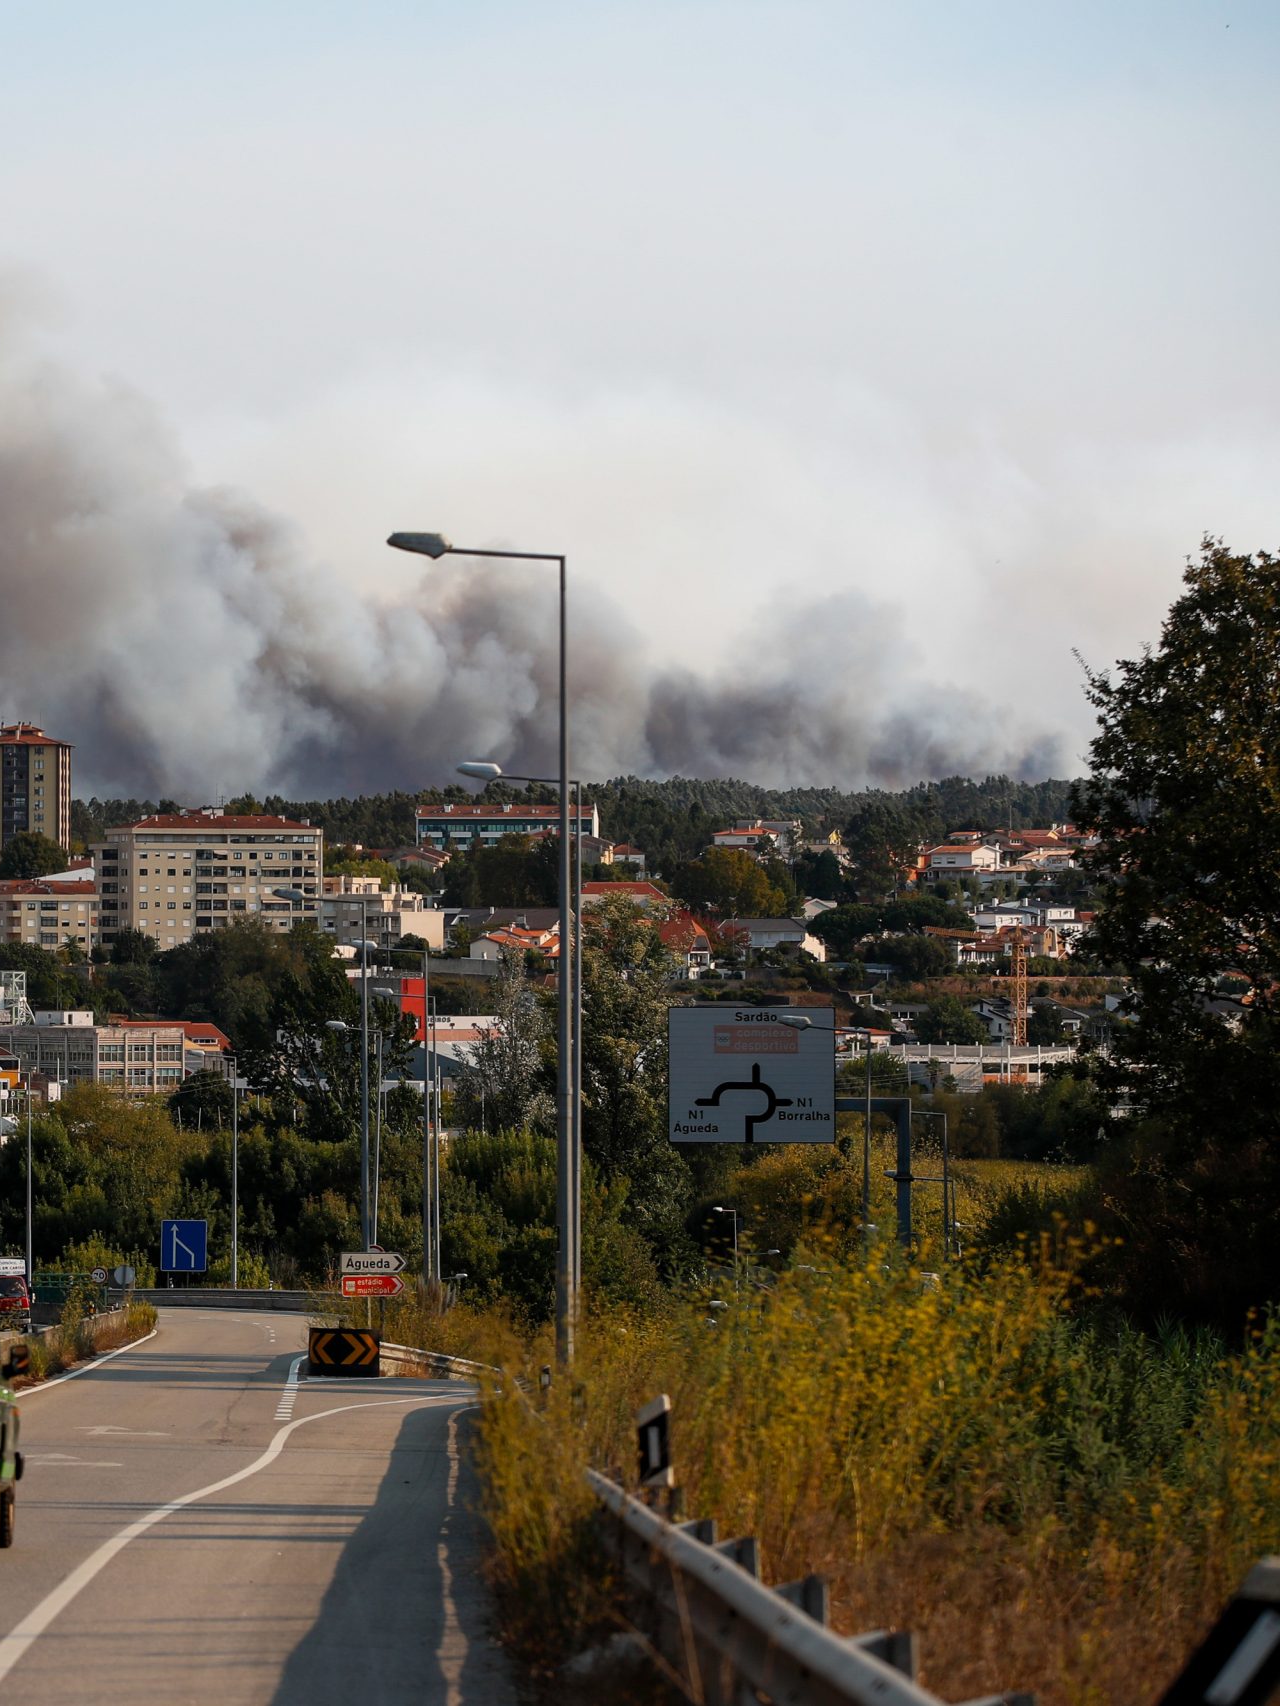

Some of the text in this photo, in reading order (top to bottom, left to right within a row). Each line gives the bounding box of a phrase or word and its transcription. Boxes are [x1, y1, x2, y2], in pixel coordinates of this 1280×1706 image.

[735, 1011, 777, 1022] Sardão
[736, 1028, 793, 1040] complexo
[734, 1041, 796, 1052] desportivo
[797, 1098, 813, 1107] N1
[688, 1110, 704, 1119] N1
[778, 1111, 830, 1121] Borralha
[673, 1121, 718, 1134] Águeda
[346, 1255, 390, 1271] Águeda
[357, 1278, 382, 1286] estádio
[357, 1286, 390, 1294] municipal
